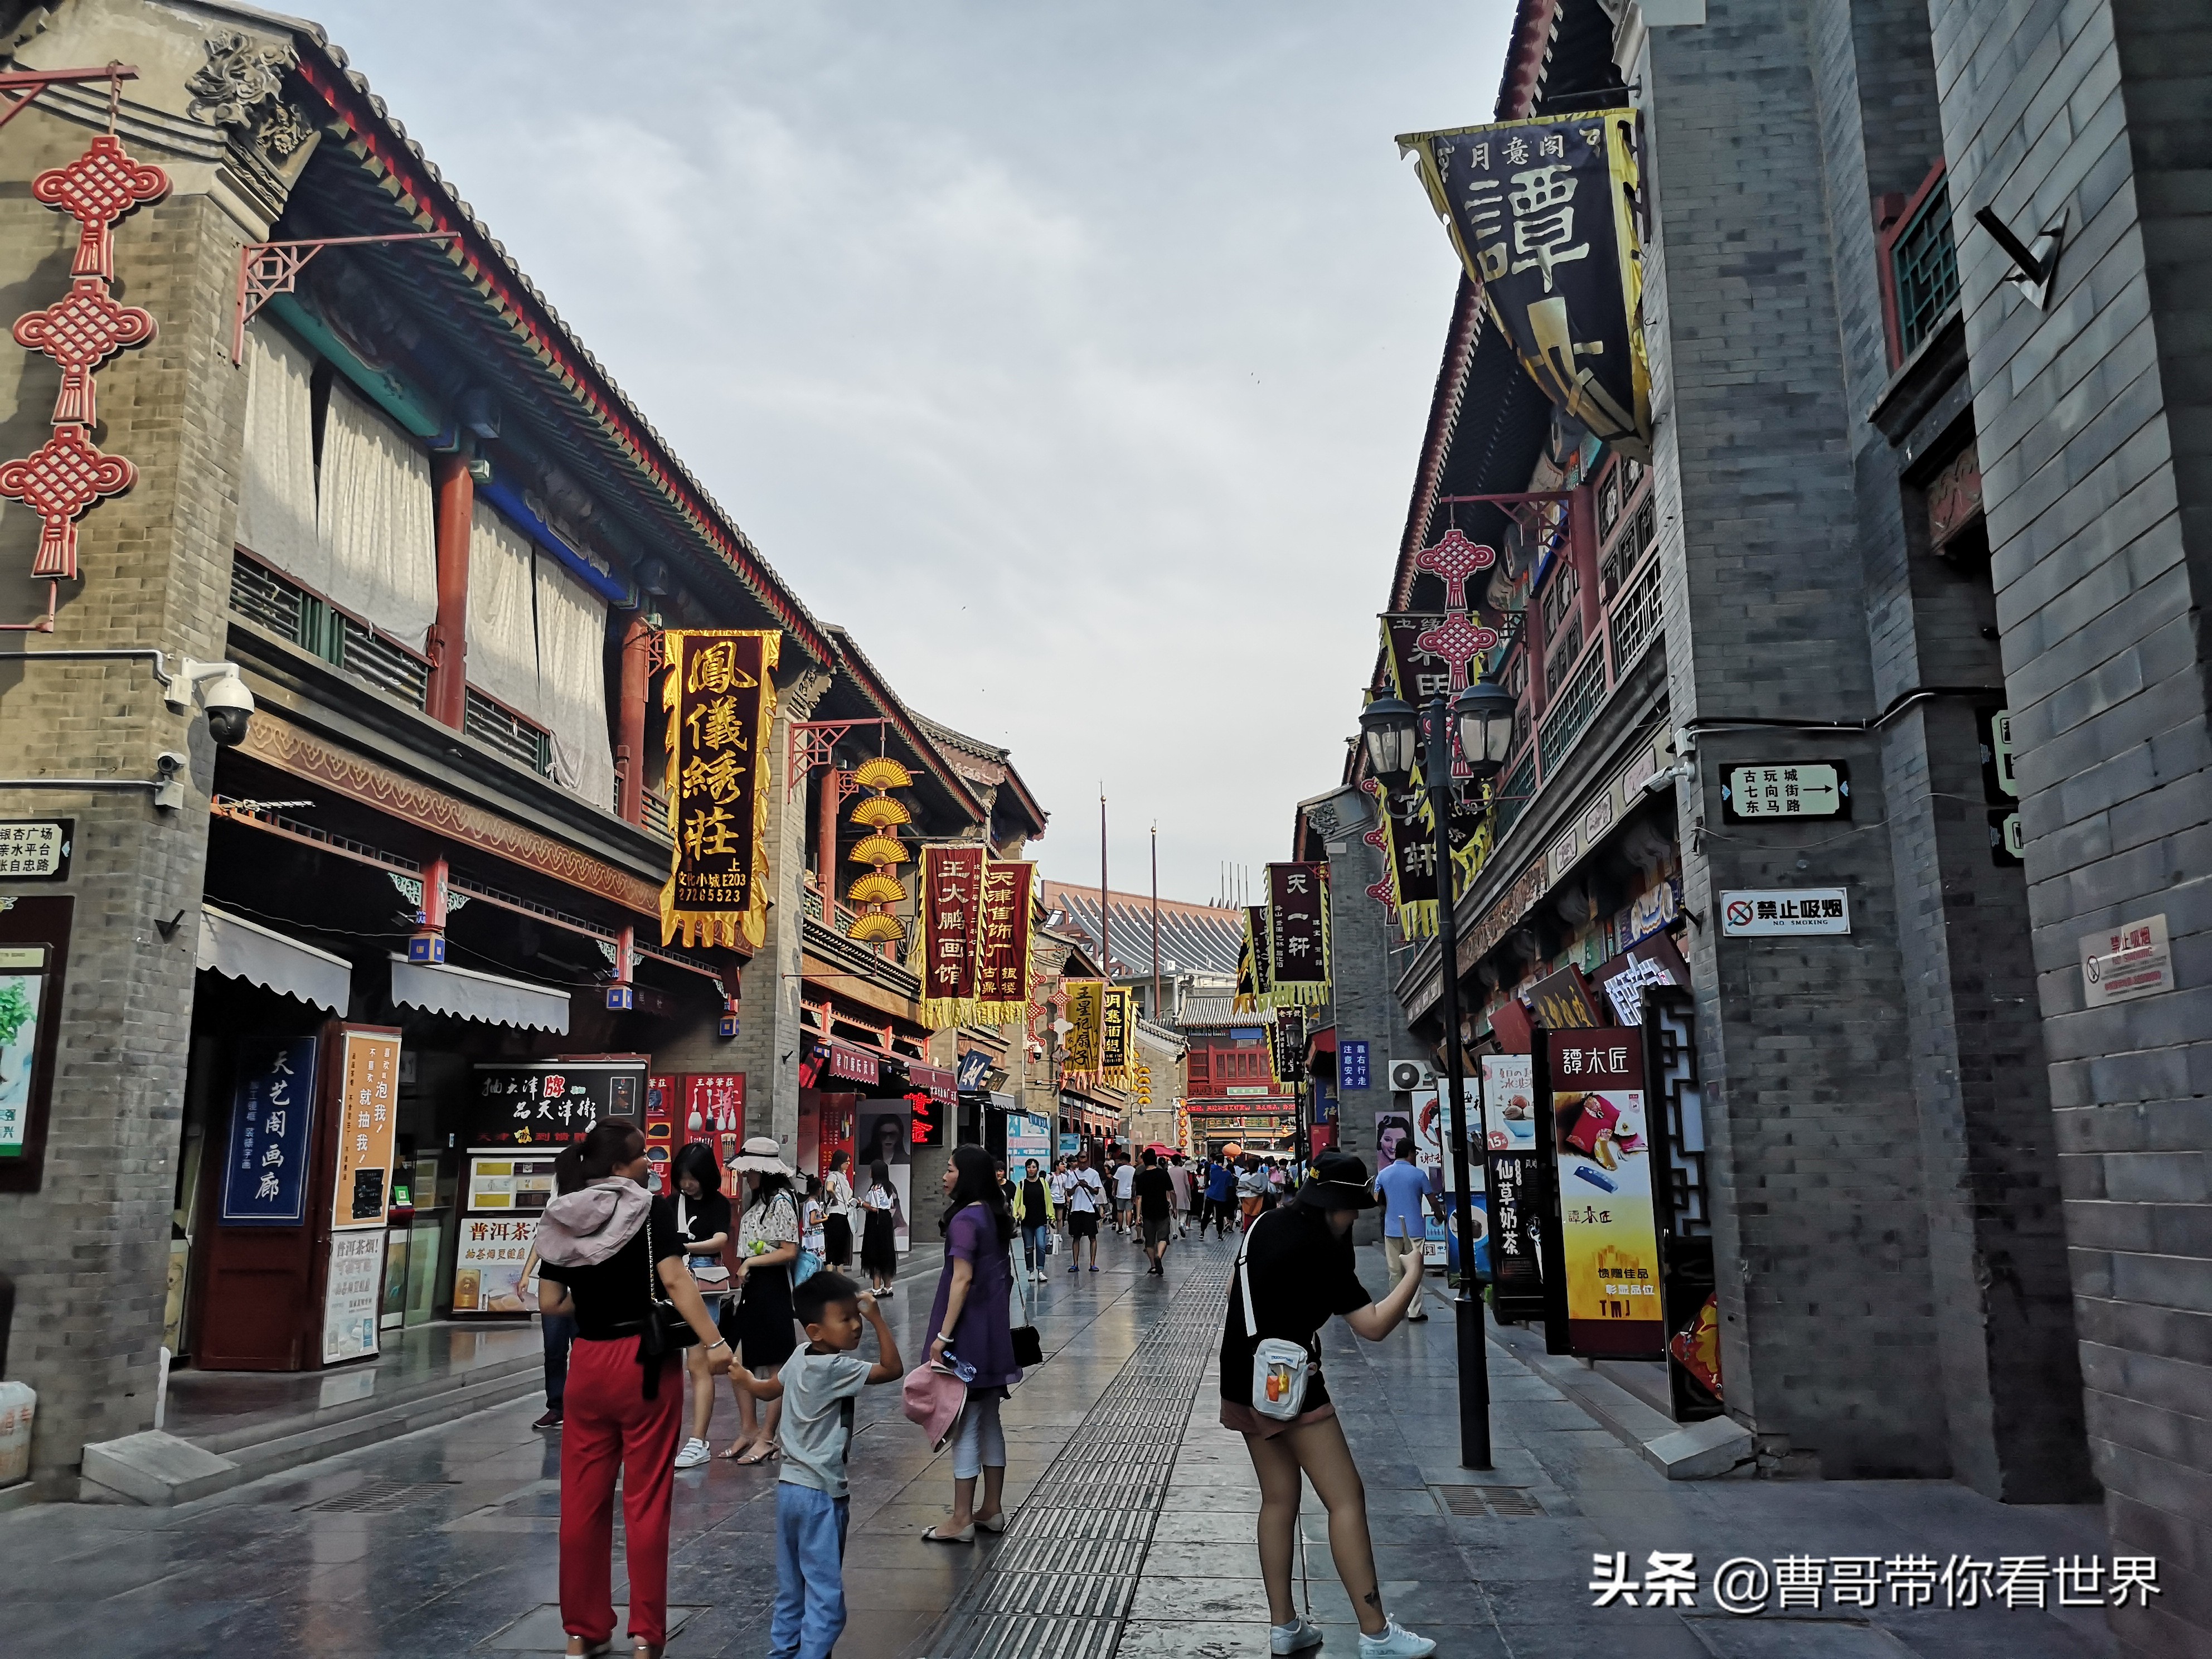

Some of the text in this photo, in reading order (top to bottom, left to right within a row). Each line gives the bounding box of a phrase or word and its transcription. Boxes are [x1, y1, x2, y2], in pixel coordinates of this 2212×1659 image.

[1743, 768, 1798, 783] 古玩城
[1744, 784, 1799, 798] 七向街
[1746, 799, 1801, 813] 东马路
[0, 828, 52, 841] 银杏广场
[0, 843, 50, 856] 亲水平台
[680, 888, 740, 902] 27265523
[986, 871, 1016, 957] 天津首饰厂
[1287, 874, 1310, 958] 天一轩
[1757, 899, 1843, 919] 禁止吸烟
[934, 860, 970, 985] 王大鹏画馆
[1343, 1045, 1353, 1085] 注意安全
[1357, 1045, 1366, 1085] 靠右行走
[1563, 1047, 1629, 1074] 譚木匠
[255, 1050, 294, 1202] 天艺阁画廊
[1496, 1158, 1520, 1254] 仙草奶茶
[1598, 1268, 1648, 1279] 馈赠佳品
[1599, 1300, 1630, 1318] TMJ
